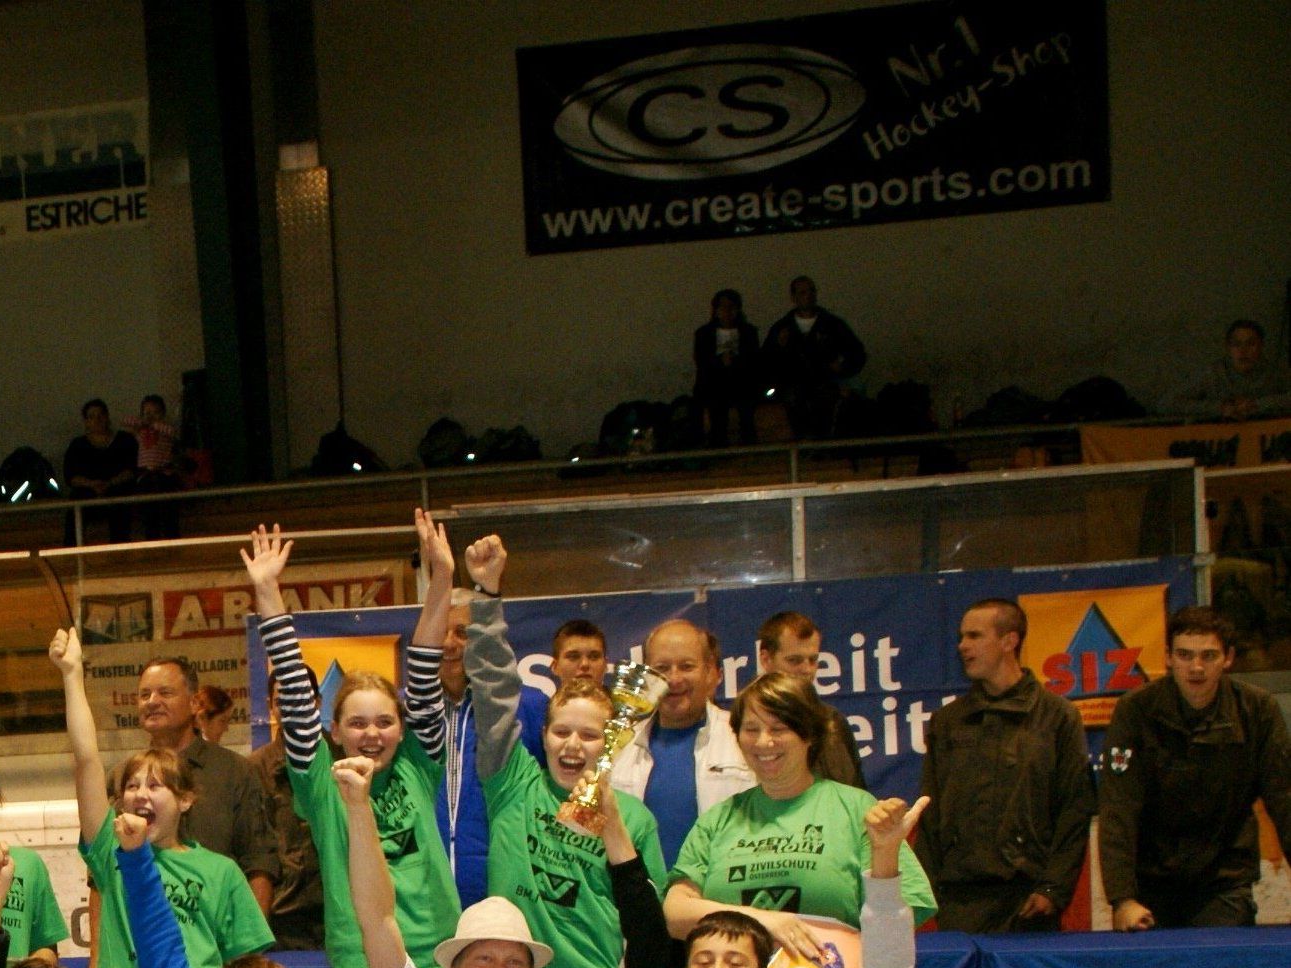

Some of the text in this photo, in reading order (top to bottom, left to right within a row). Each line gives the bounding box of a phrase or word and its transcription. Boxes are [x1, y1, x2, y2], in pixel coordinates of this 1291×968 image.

[627, 75, 790, 147] CS
[862, 32, 1072, 161] Hockey-Shop
[26, 193, 147, 232] ESTRICHE
[544, 157, 1092, 240] www.create-sports.com
[1042, 646, 1144, 696] SIZ
[737, 834, 794, 849] SAFETY
[749, 859, 817, 872] ZIVILSCHUTZ
